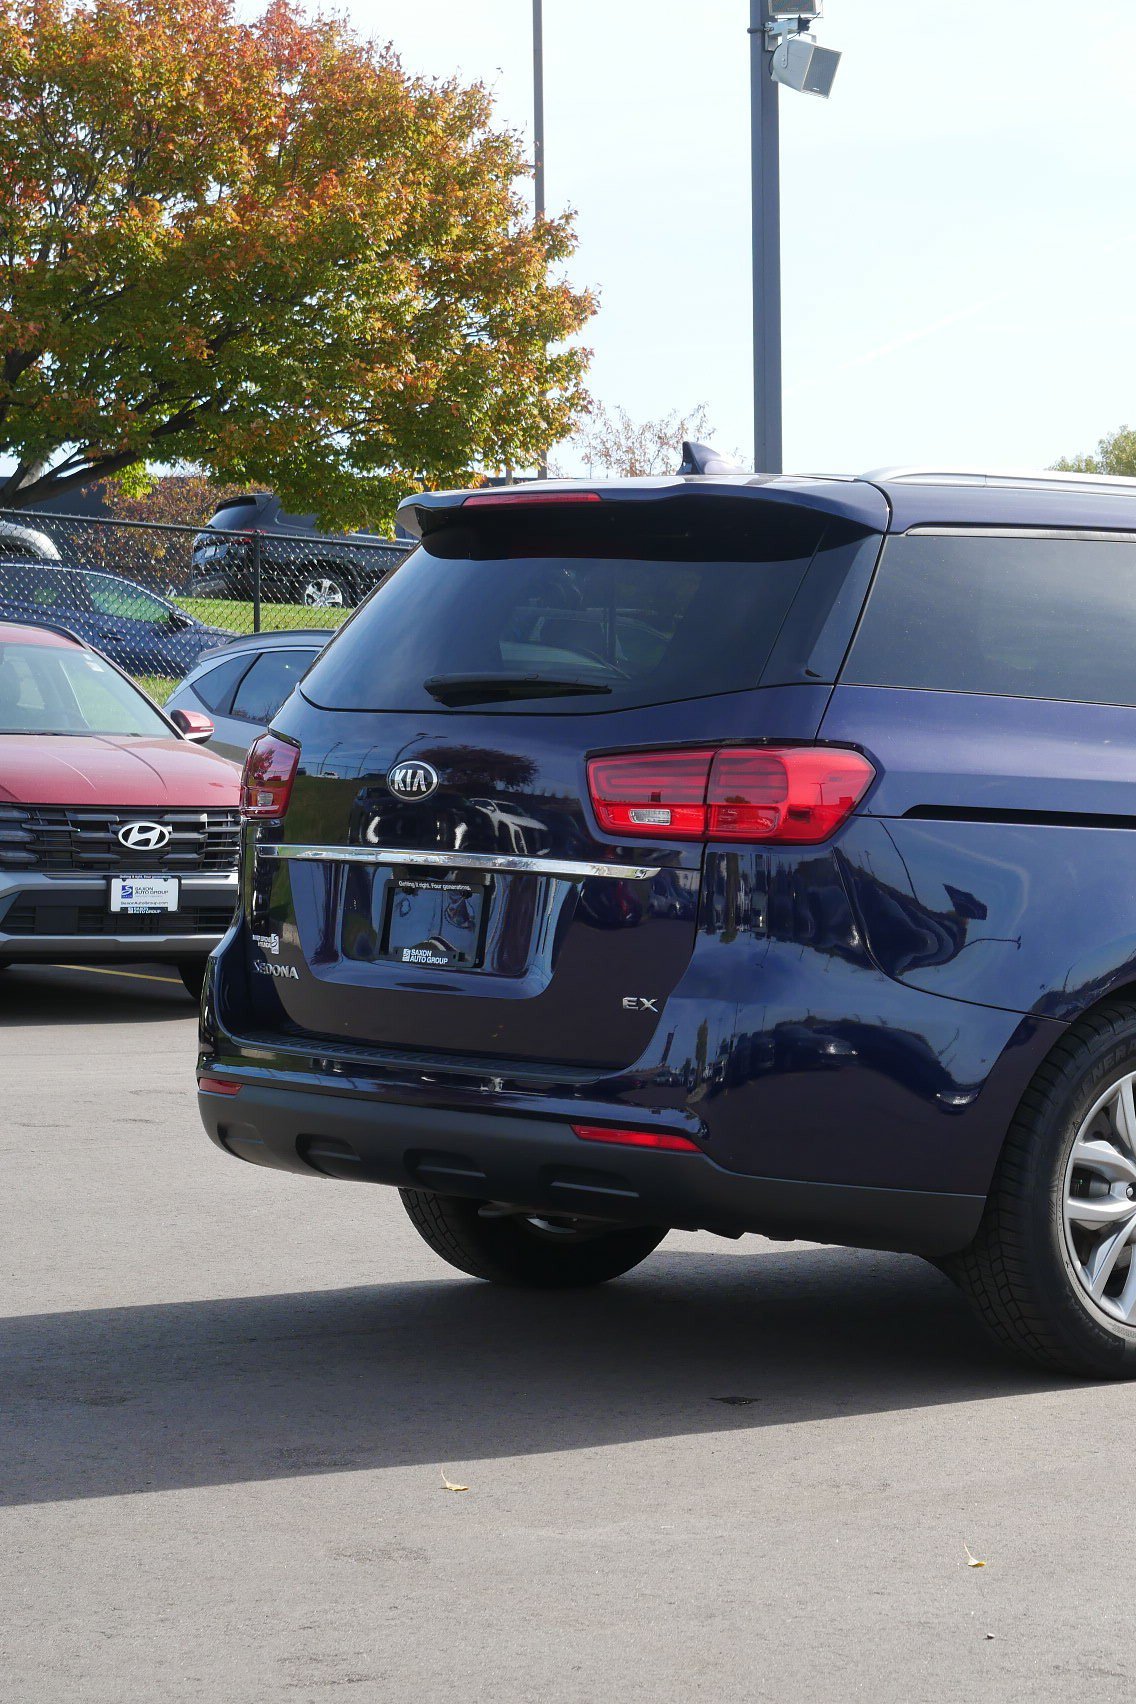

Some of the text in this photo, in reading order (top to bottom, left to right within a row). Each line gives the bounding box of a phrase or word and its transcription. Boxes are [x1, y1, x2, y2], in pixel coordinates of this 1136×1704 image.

[394, 769, 427, 792] KIA
[410, 948, 433, 956] SAXON
[410, 955, 427, 963] AUTO
[426, 956, 449, 964] GROUP
[622, 996, 659, 1013] EX
